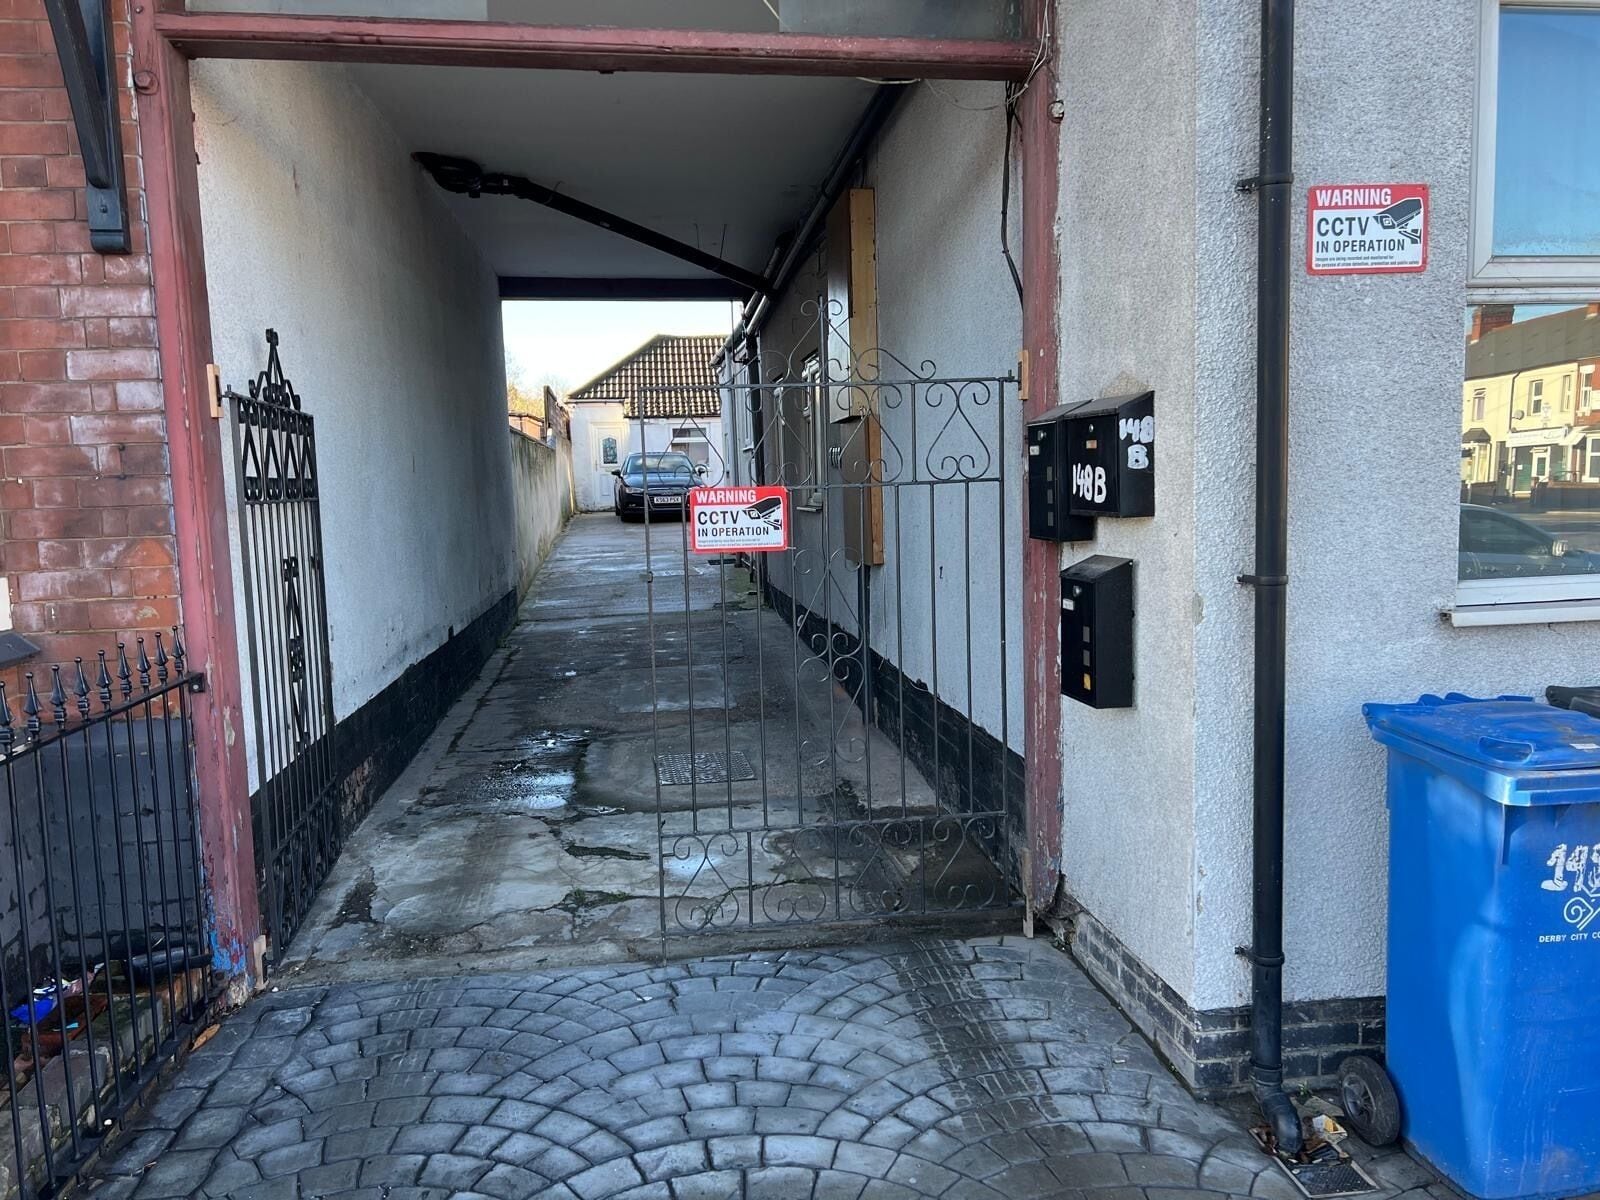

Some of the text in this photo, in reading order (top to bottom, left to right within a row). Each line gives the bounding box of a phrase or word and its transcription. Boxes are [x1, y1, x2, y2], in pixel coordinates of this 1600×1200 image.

[1315, 188, 1392, 207] WARNING
[1317, 216, 1370, 237] CCTV
[1316, 239, 1405, 253] IN OPERATION
[1127, 444, 1149, 469] B
[1072, 462, 1107, 503] 148B
[695, 489, 757, 504] WARNING
[697, 510, 740, 525] CCTV
[697, 526, 769, 537] IN OPERATION
[1538, 934, 1567, 943] DERBY
[1570, 932, 1589, 941] CITY
